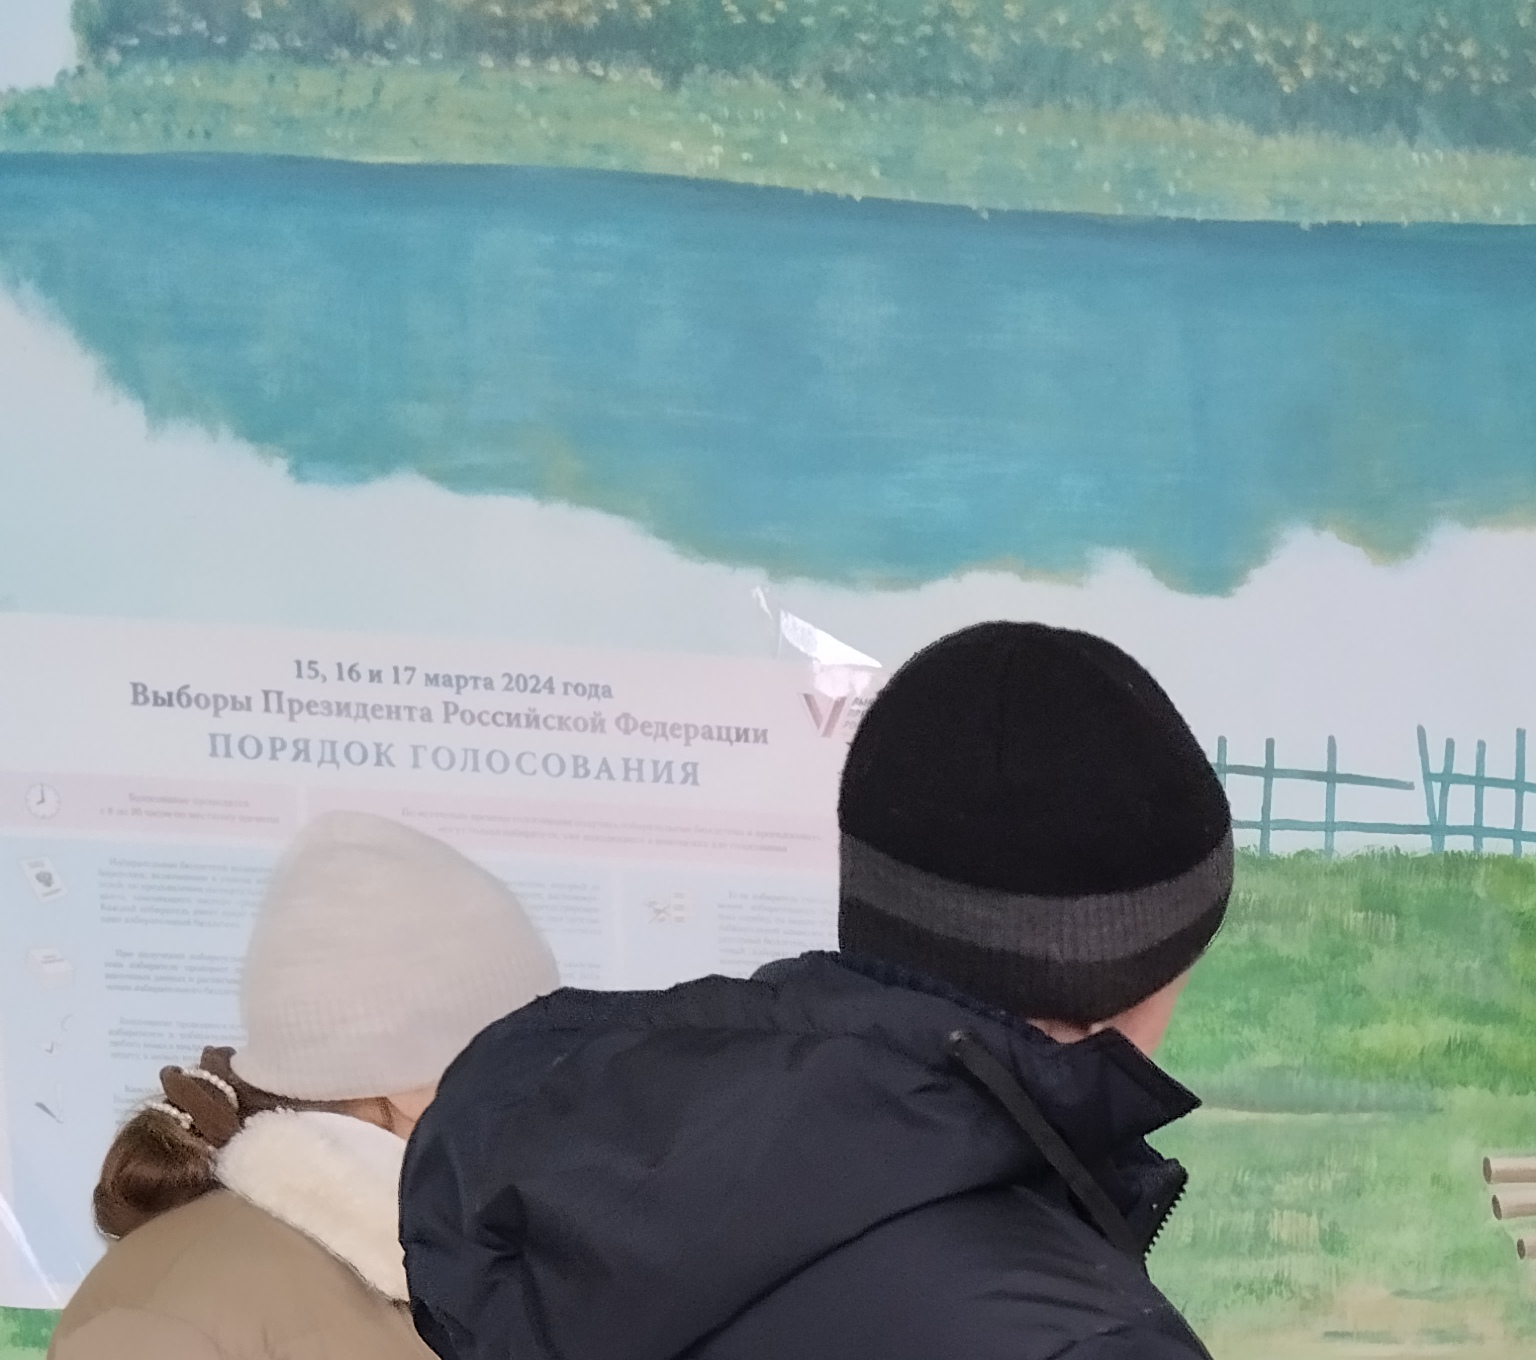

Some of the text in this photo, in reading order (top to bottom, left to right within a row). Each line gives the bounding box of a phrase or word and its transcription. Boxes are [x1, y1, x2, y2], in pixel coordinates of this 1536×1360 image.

[294, 659, 614, 701] 15, 16 и 17 марта 2024 года
[129, 681, 769, 747] Выборы Президента Российской Федерации
[208, 733, 700, 787] ПОРЯДОК ГОЛОСОВАНИЯ
